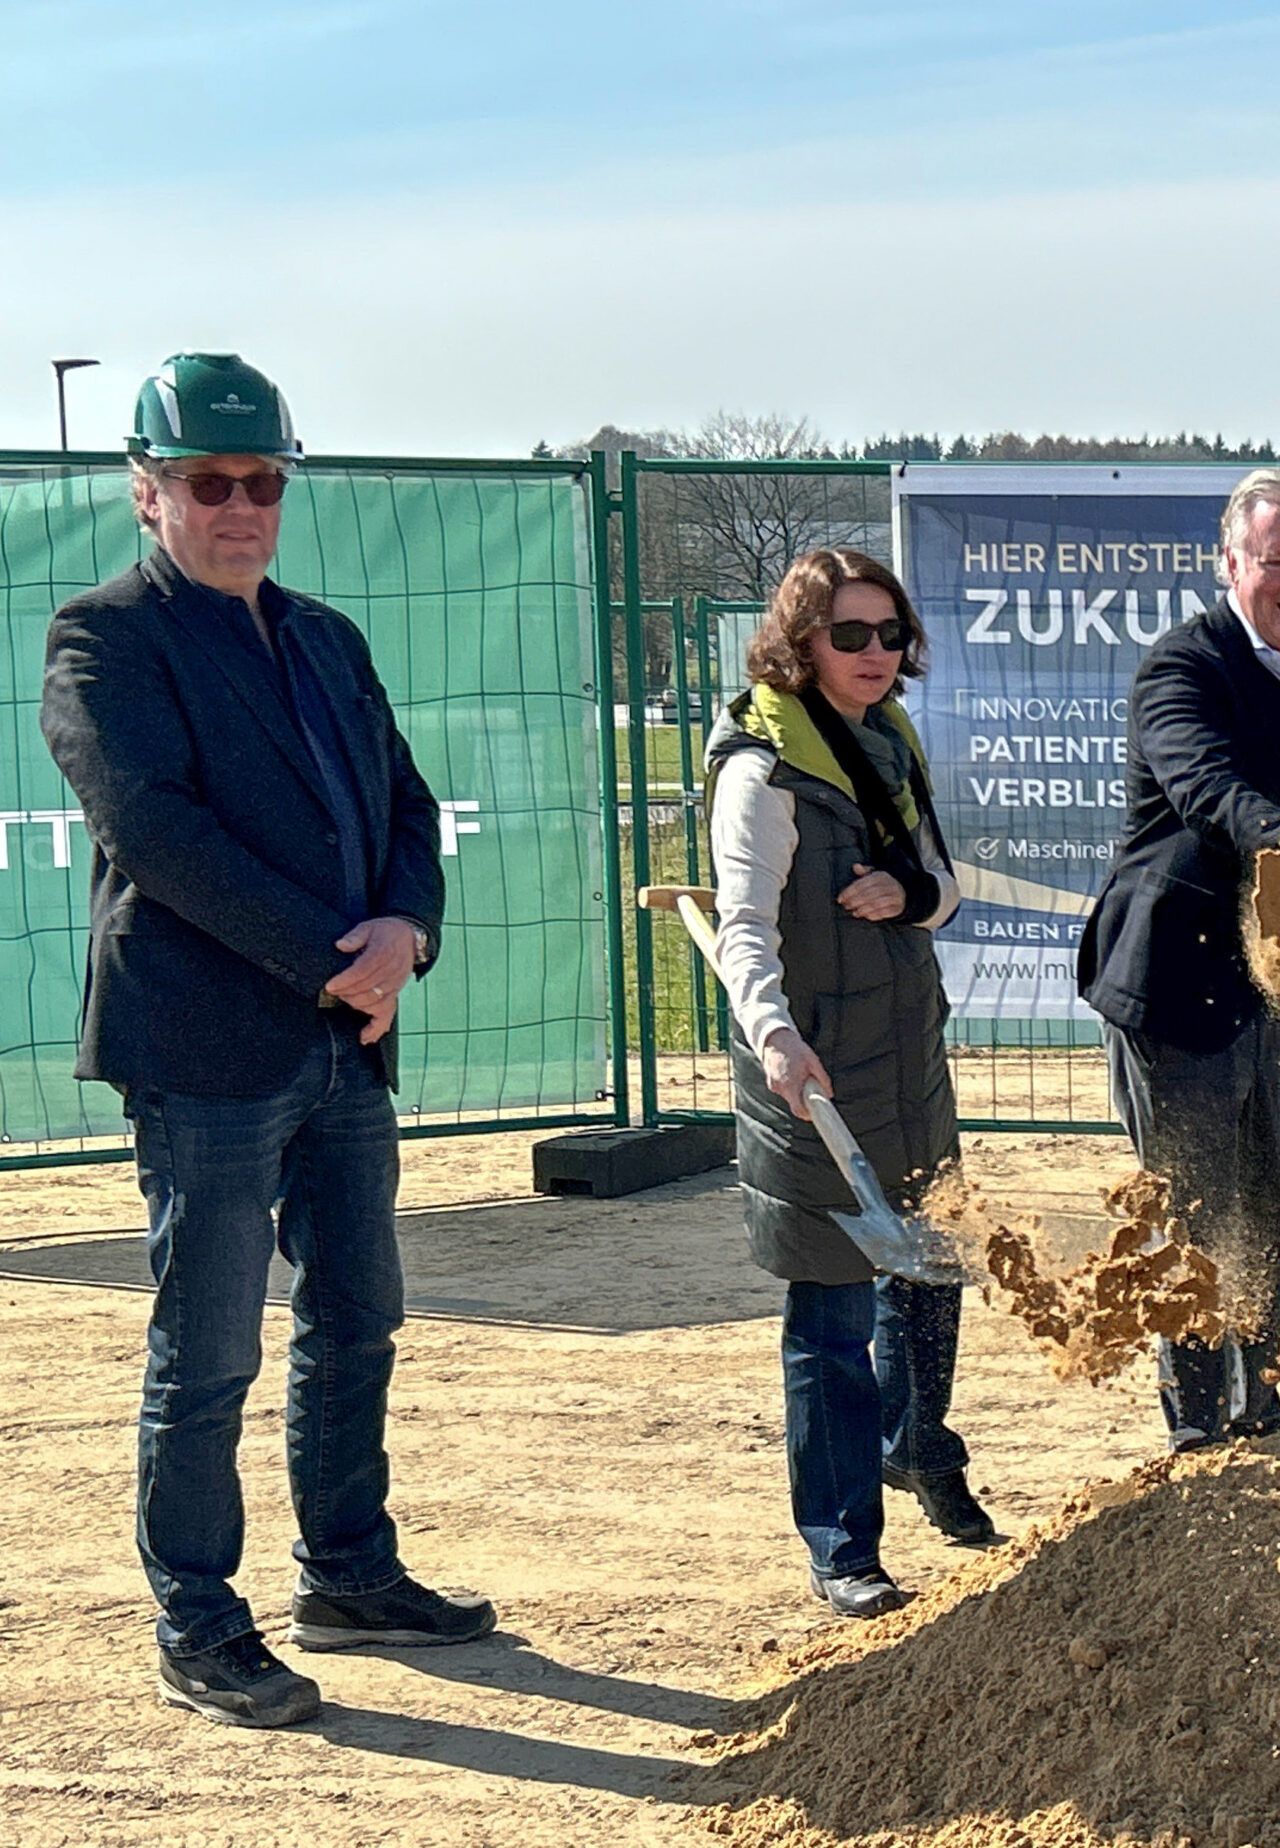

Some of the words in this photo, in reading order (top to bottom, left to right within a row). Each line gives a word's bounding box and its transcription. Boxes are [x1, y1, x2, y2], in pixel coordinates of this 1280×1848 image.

[964, 543, 1045, 573] HIER
[1008, 838, 1120, 859] Maschinel
[974, 920, 1059, 940] BAUEN
